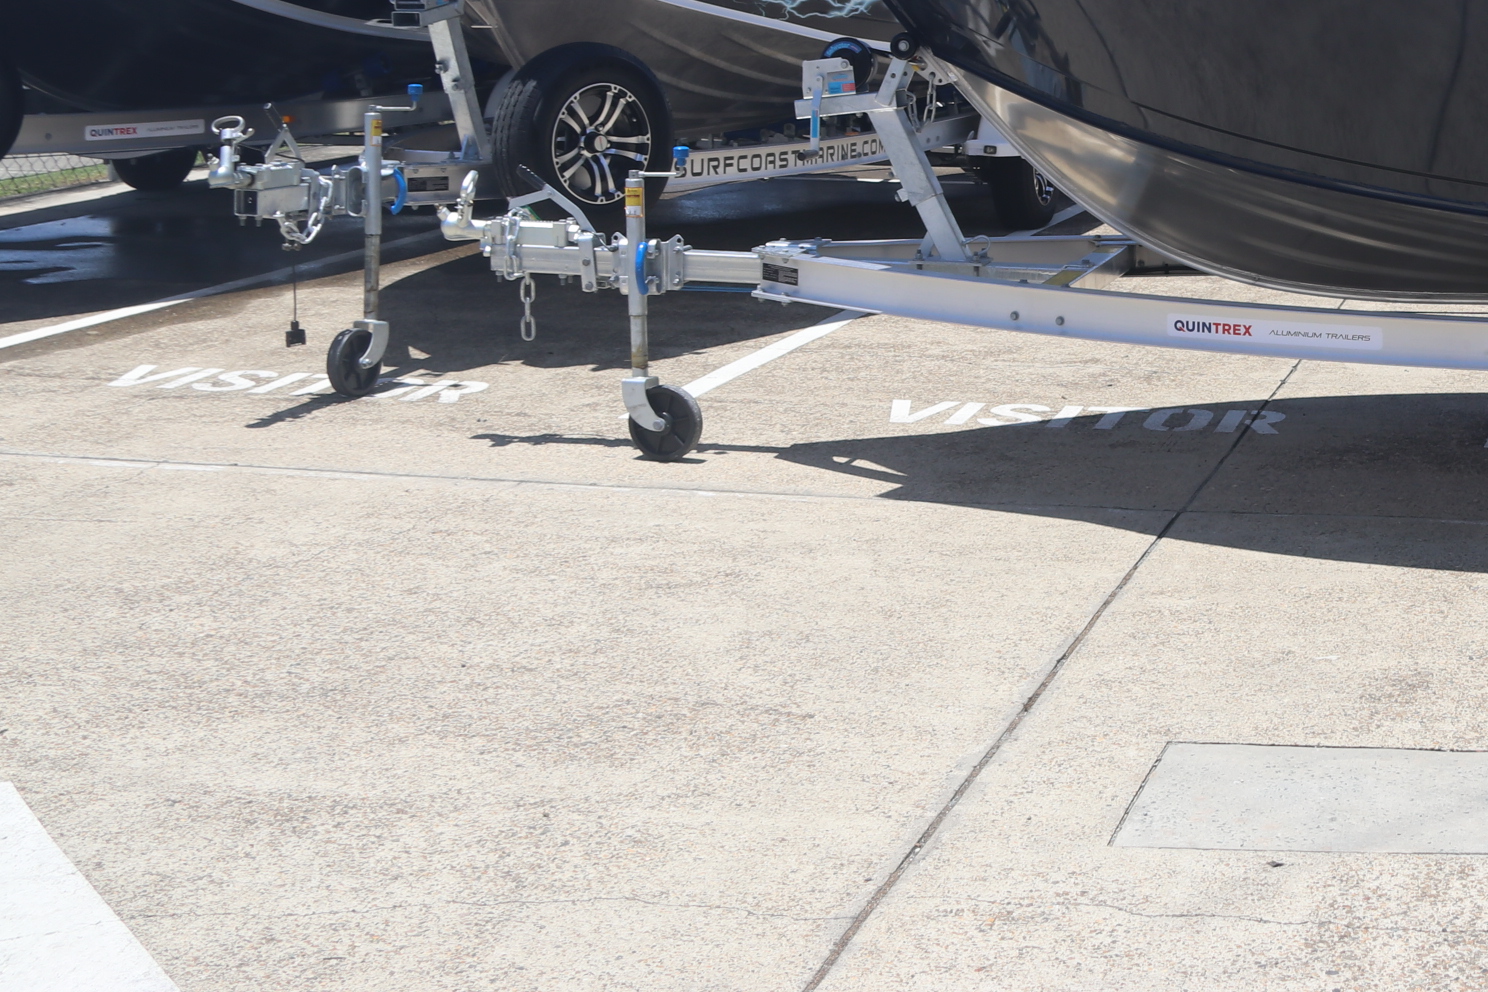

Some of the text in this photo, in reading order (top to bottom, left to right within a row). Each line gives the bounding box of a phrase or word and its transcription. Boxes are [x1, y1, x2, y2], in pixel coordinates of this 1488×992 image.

[89, 126, 138, 137] QUINTREX
[1174, 319, 1371, 342] QUINTREX ALUMINIUM TRAILERS
[888, 399, 1287, 435] VISITOR
